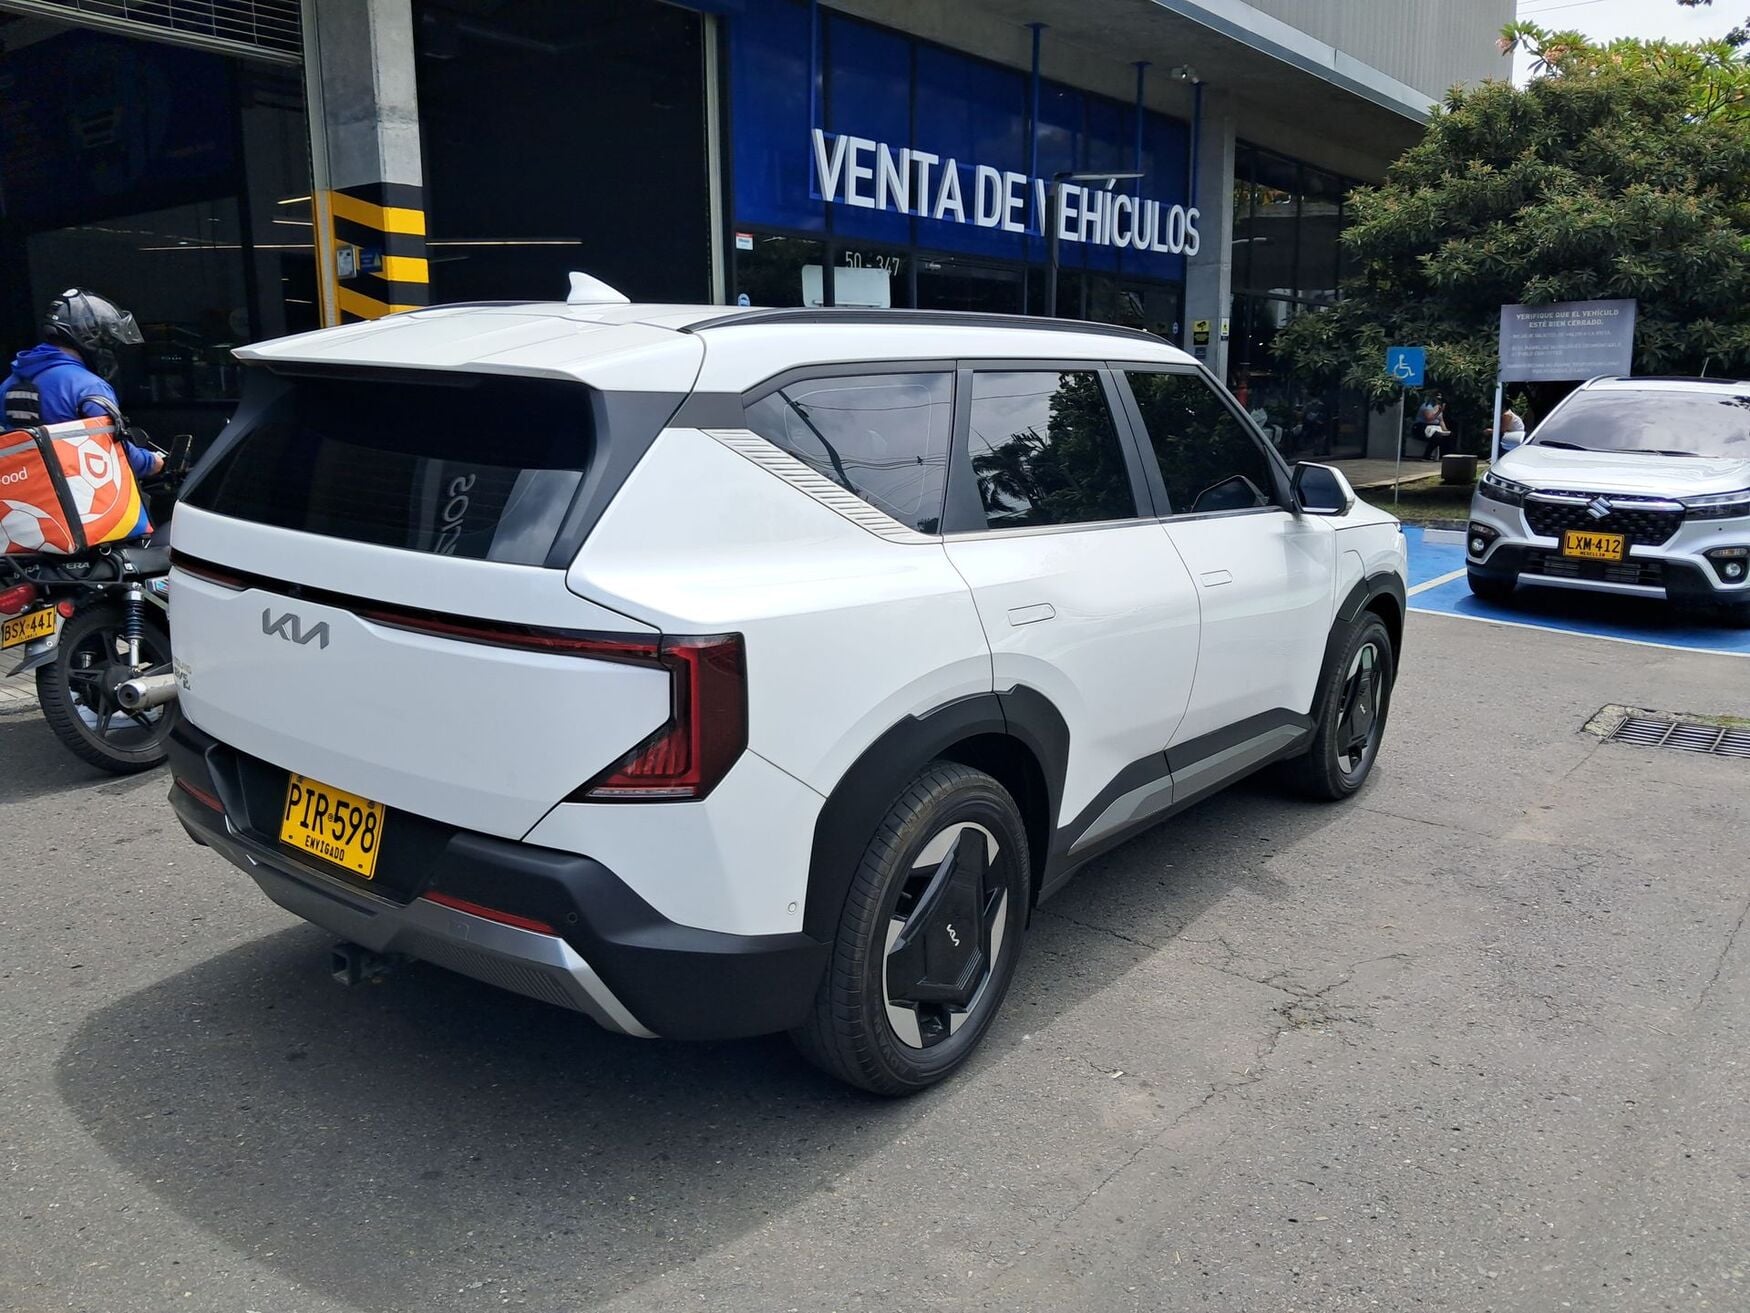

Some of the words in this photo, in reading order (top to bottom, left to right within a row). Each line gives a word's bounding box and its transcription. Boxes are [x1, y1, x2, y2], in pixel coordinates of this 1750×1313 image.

[811, 128, 966, 224] VENTA
[974, 164, 1027, 234] DE
[845, 251, 862, 269] 50
[1516, 311, 1554, 320] VERIFIQUE
[1555, 311, 1569, 319] QUE
[1571, 310, 1581, 318] EL
[0, 466, 28, 485] ood
[262, 608, 330, 650] KIA
[305, 834, 345, 862] ENVIGADO
